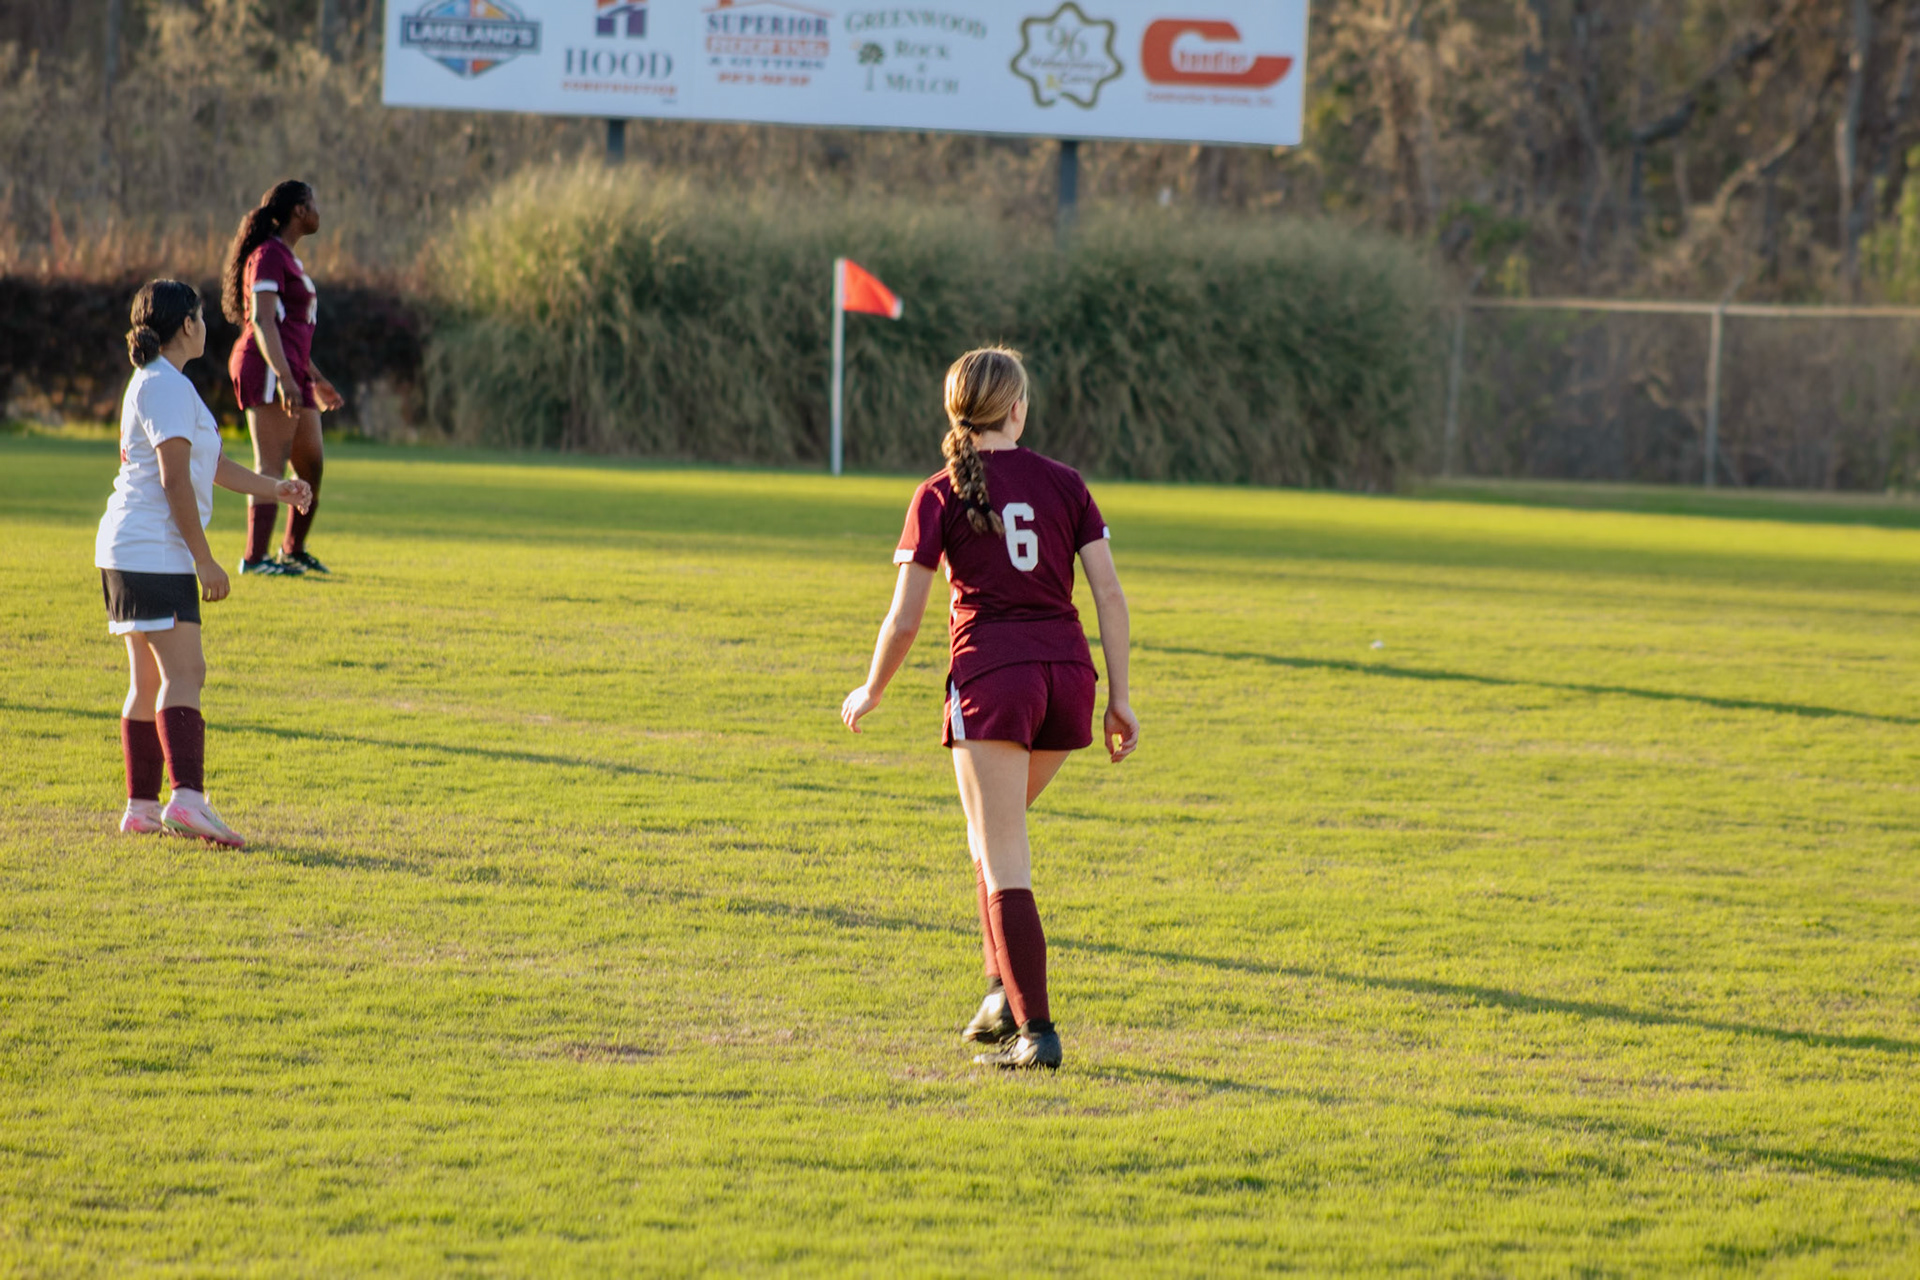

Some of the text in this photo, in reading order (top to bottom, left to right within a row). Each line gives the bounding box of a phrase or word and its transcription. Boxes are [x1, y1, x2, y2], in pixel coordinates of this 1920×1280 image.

[408, 22, 534, 46] LAKELAND'S
[706, 14, 829, 37] SUPERIOR
[845, 9, 988, 40] GREENWOOD
[1046, 26, 1089, 61] 96
[565, 48, 674, 80] HOOD
[1002, 502, 1039, 572] 6
